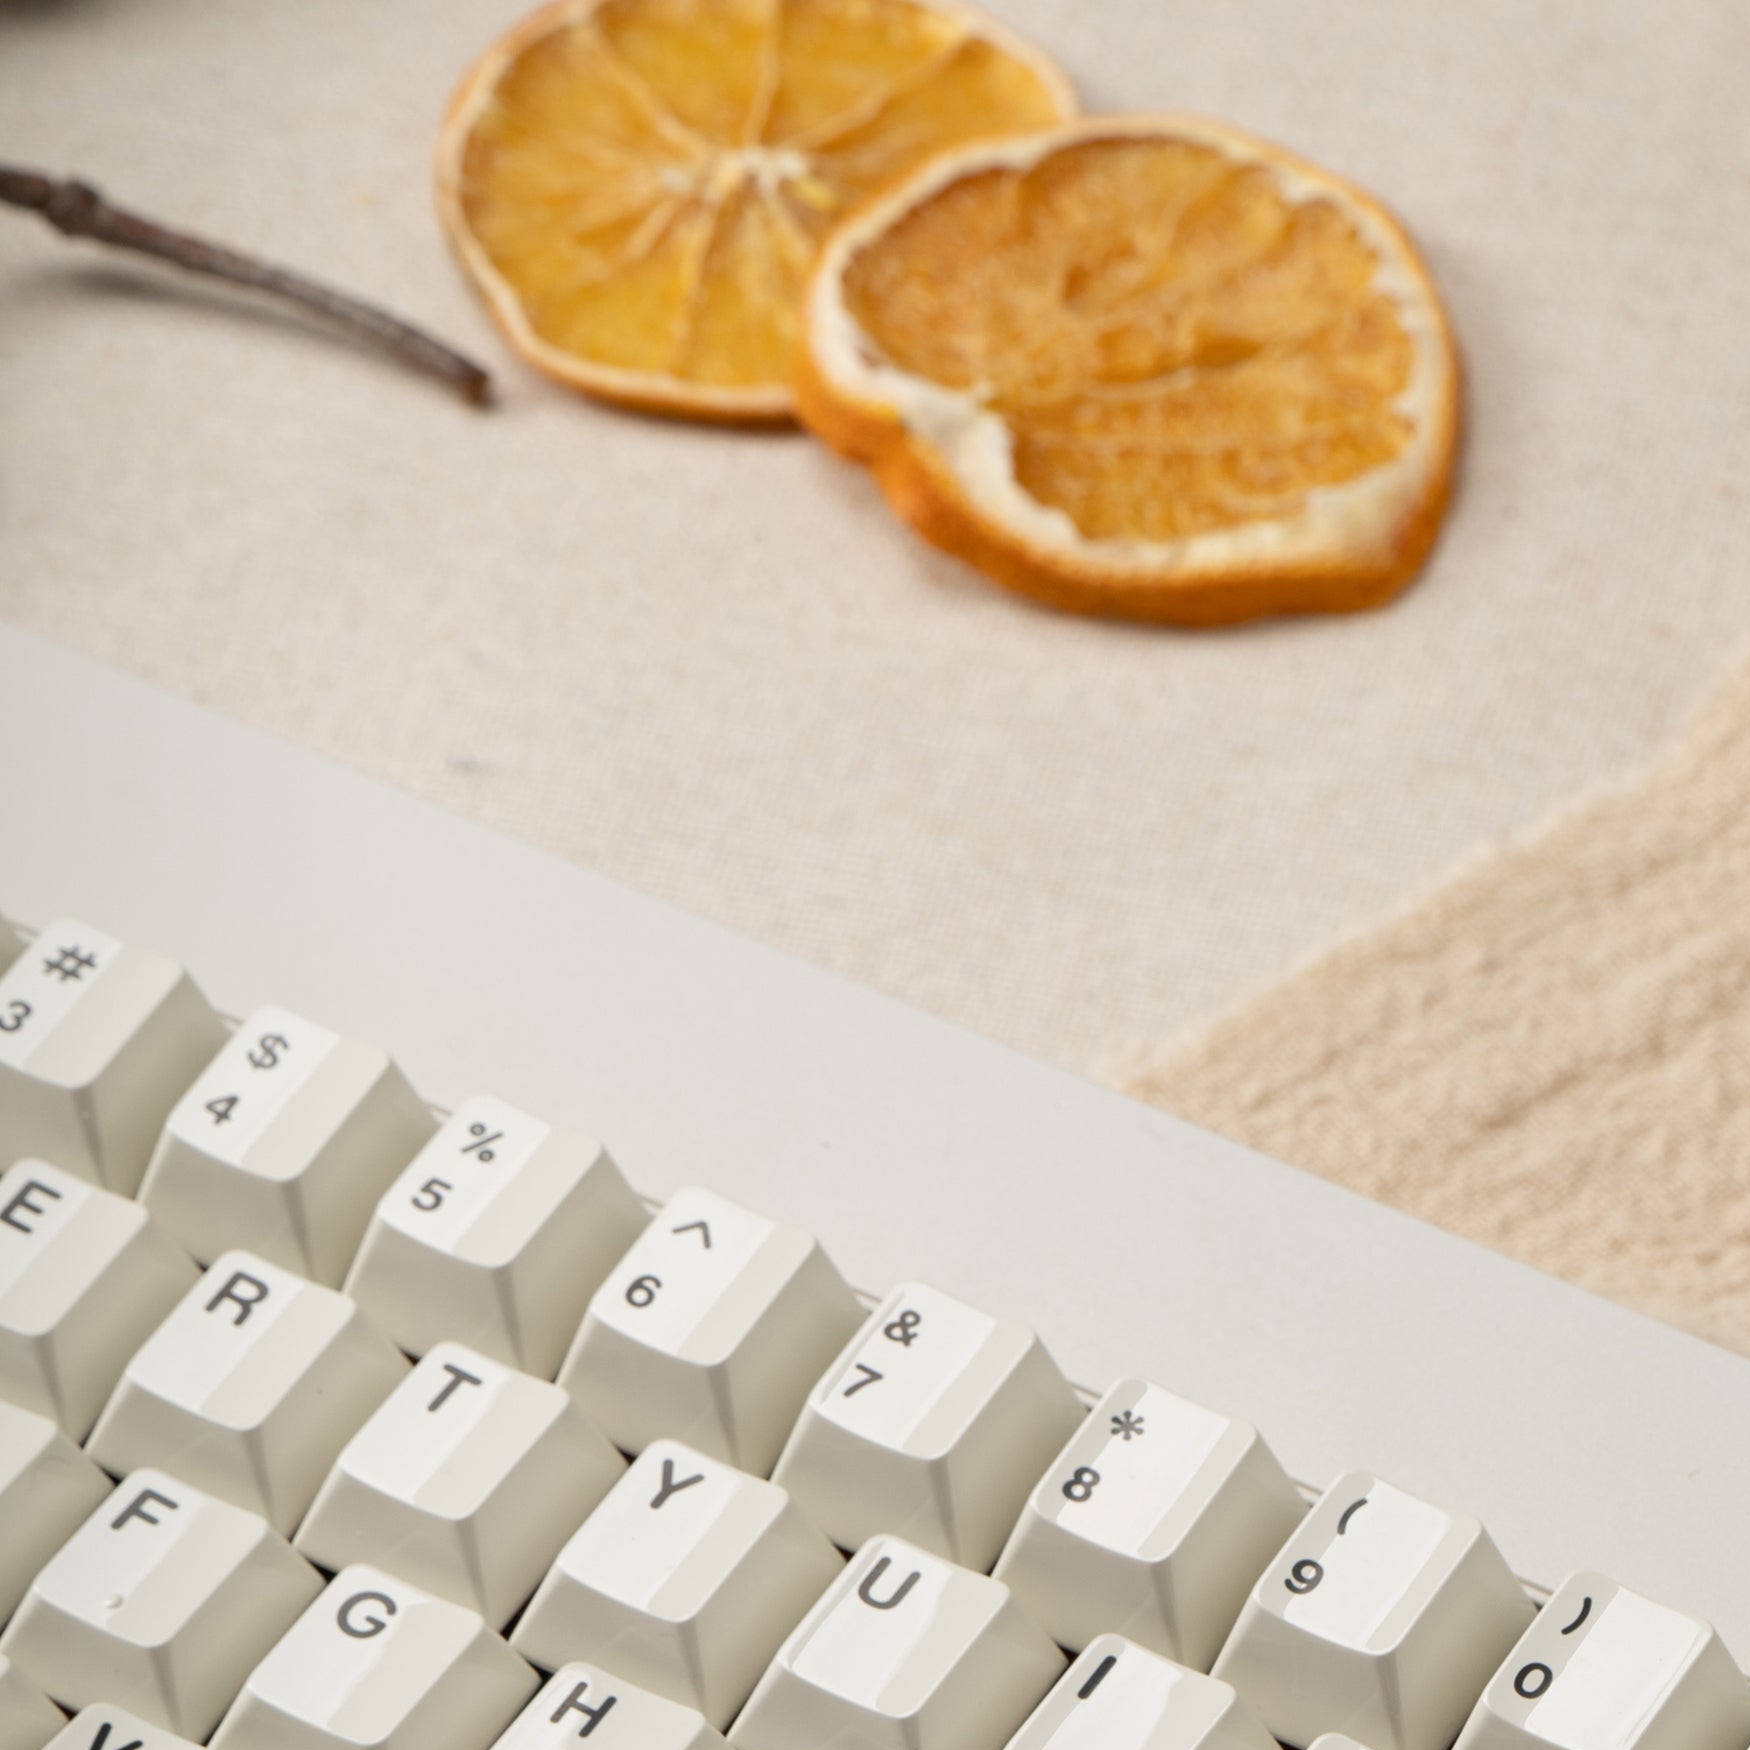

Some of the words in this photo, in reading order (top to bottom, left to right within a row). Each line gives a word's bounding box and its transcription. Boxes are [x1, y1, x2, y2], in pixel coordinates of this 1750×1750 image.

[0, 999, 34, 1034] 3
[204, 1094, 240, 1126] 4
[0, 1179, 62, 1235] E
[410, 1176, 454, 1213] 5
[204, 1270, 270, 1328] R
[624, 1273, 663, 1310] 6
[426, 1362, 484, 1414] T
[842, 1362, 885, 1399] 7
[648, 1457, 706, 1511] Y
[1060, 1465, 1102, 1504] 8
[109, 1487, 180, 1532] F
[856, 1555, 922, 1611] U
[1282, 1557, 1325, 1596] 9
[335, 1590, 398, 1640] G
[549, 1680, 619, 1740] H
